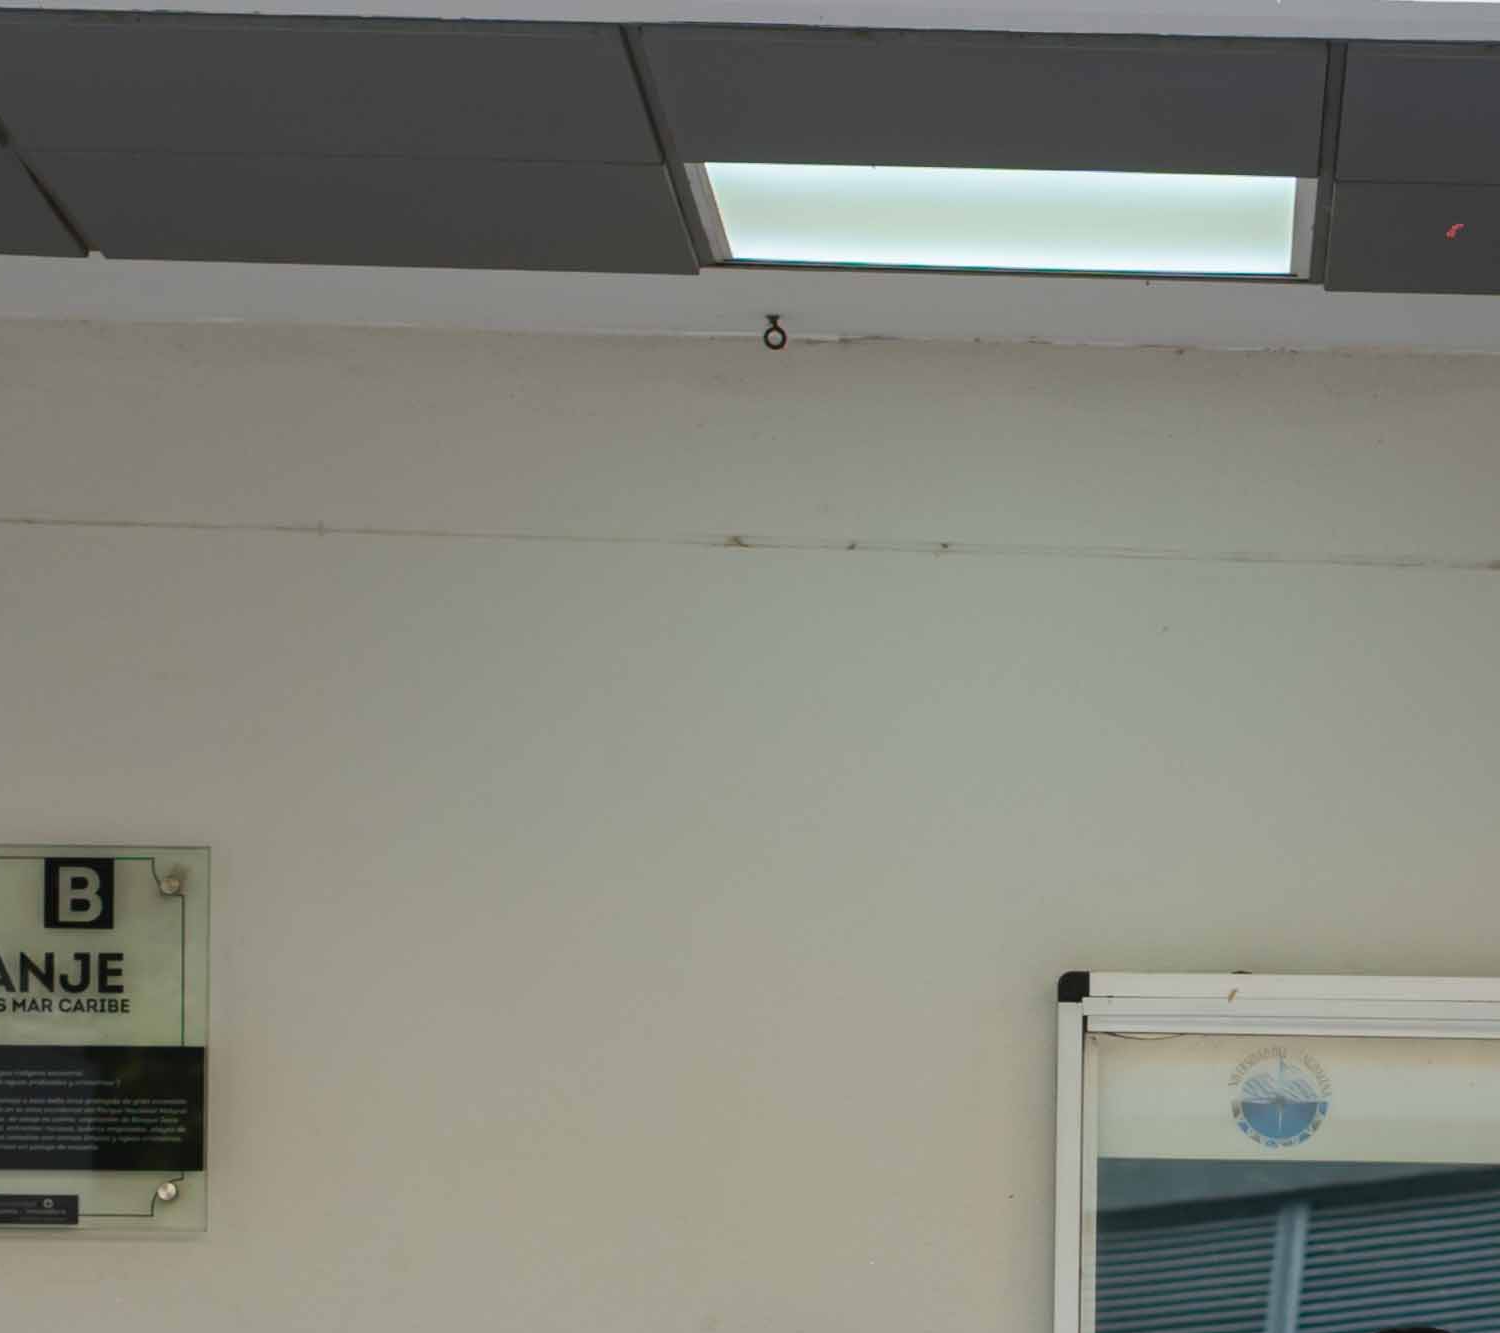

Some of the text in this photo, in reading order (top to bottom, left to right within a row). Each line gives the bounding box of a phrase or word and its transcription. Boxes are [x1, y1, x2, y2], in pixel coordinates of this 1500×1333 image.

[59, 866, 102, 922] B
[12, 997, 51, 1013] MAR
[58, 997, 130, 1014] CARIBE
